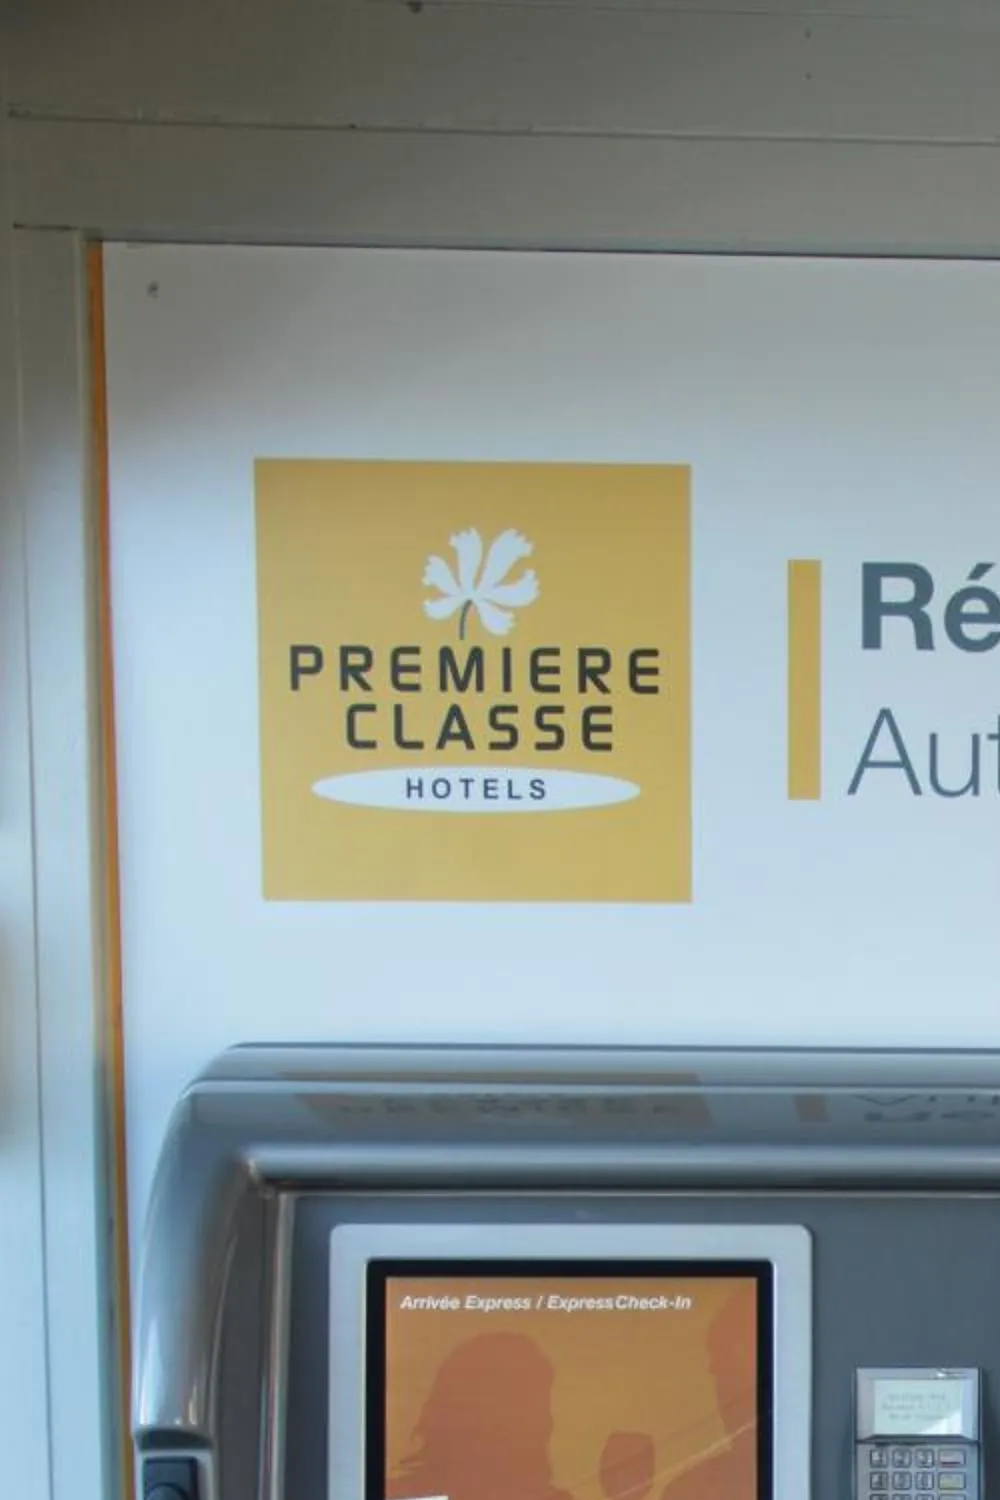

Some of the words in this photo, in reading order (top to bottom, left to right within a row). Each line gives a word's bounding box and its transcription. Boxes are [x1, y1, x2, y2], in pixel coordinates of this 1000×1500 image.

[289, 643, 662, 695] PREMIERE
[345, 703, 615, 752] CLASSE
[405, 777, 548, 801] HOTELS
[400, 1295, 460, 1309] Arrivée
[465, 1295, 531, 1312] Express
